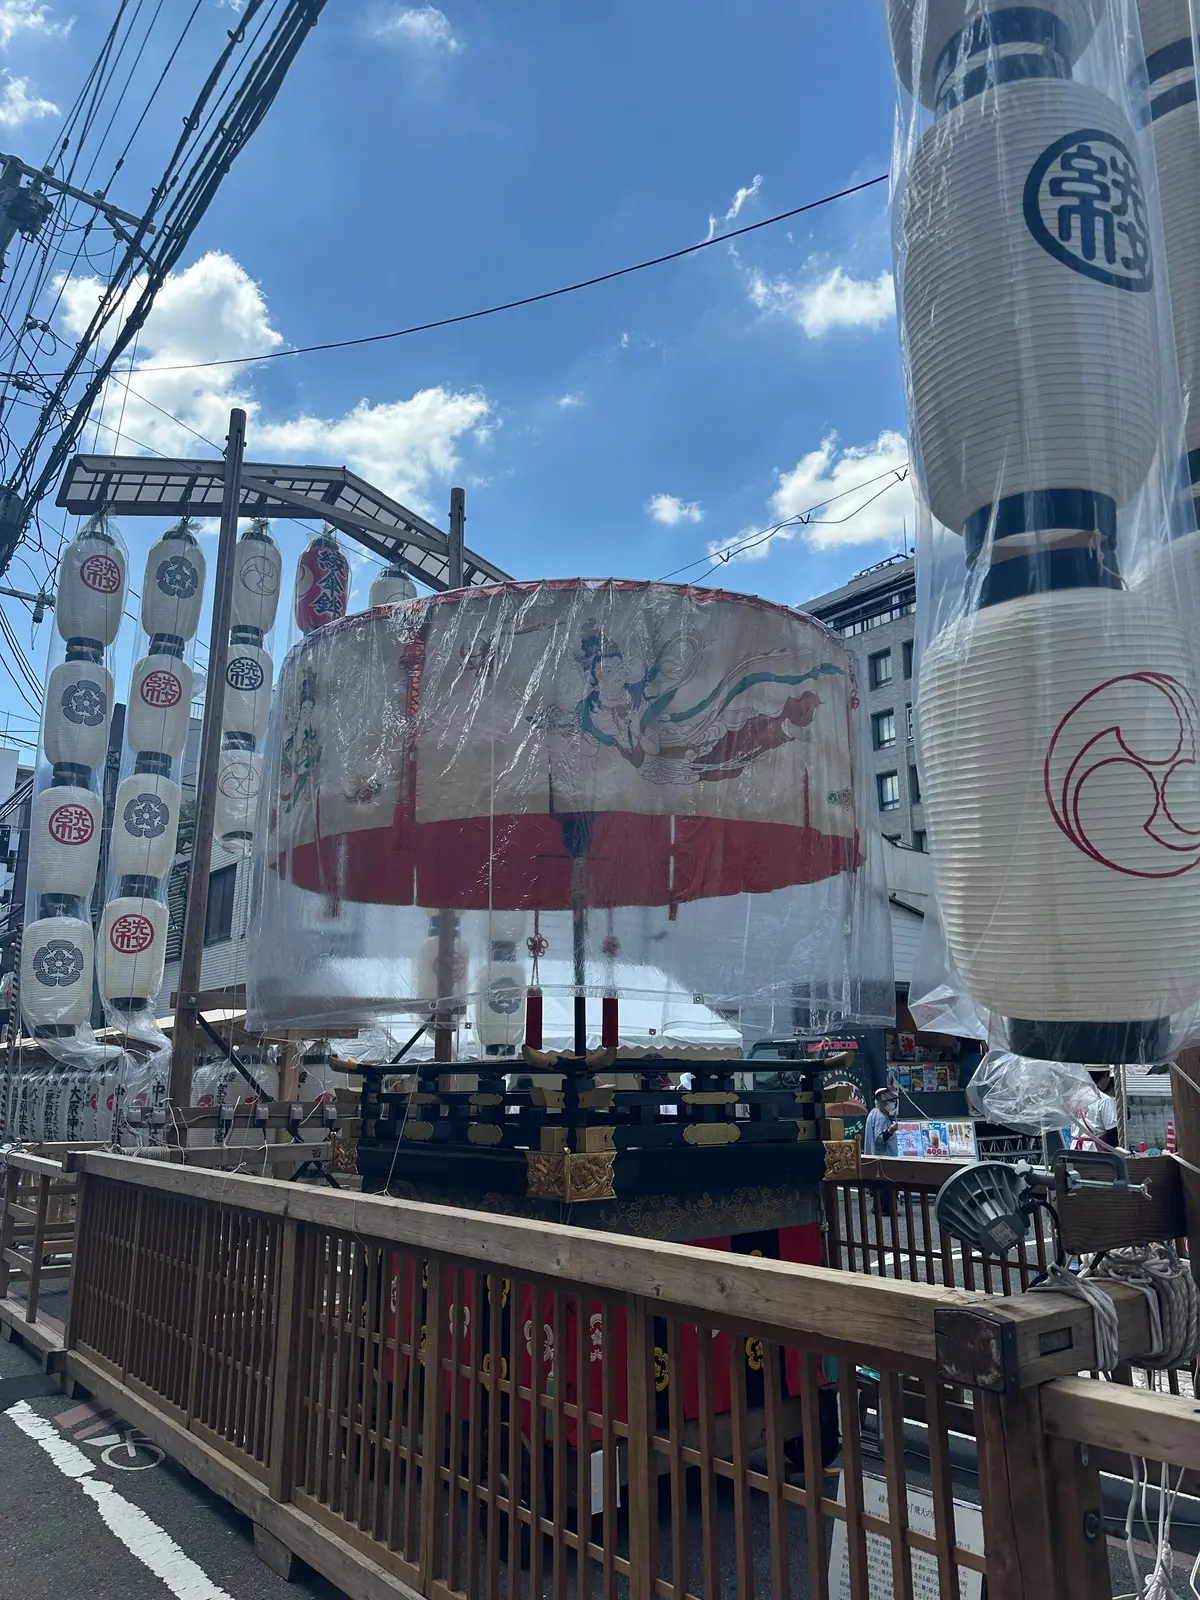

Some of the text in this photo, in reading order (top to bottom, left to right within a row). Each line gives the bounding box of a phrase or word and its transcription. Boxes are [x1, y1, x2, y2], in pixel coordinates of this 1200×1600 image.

[312, 549, 348, 620] 綾傘鉾
[844, 1120, 863, 1137] FFLE
[922, 1122, 947, 1131] 生ビール
